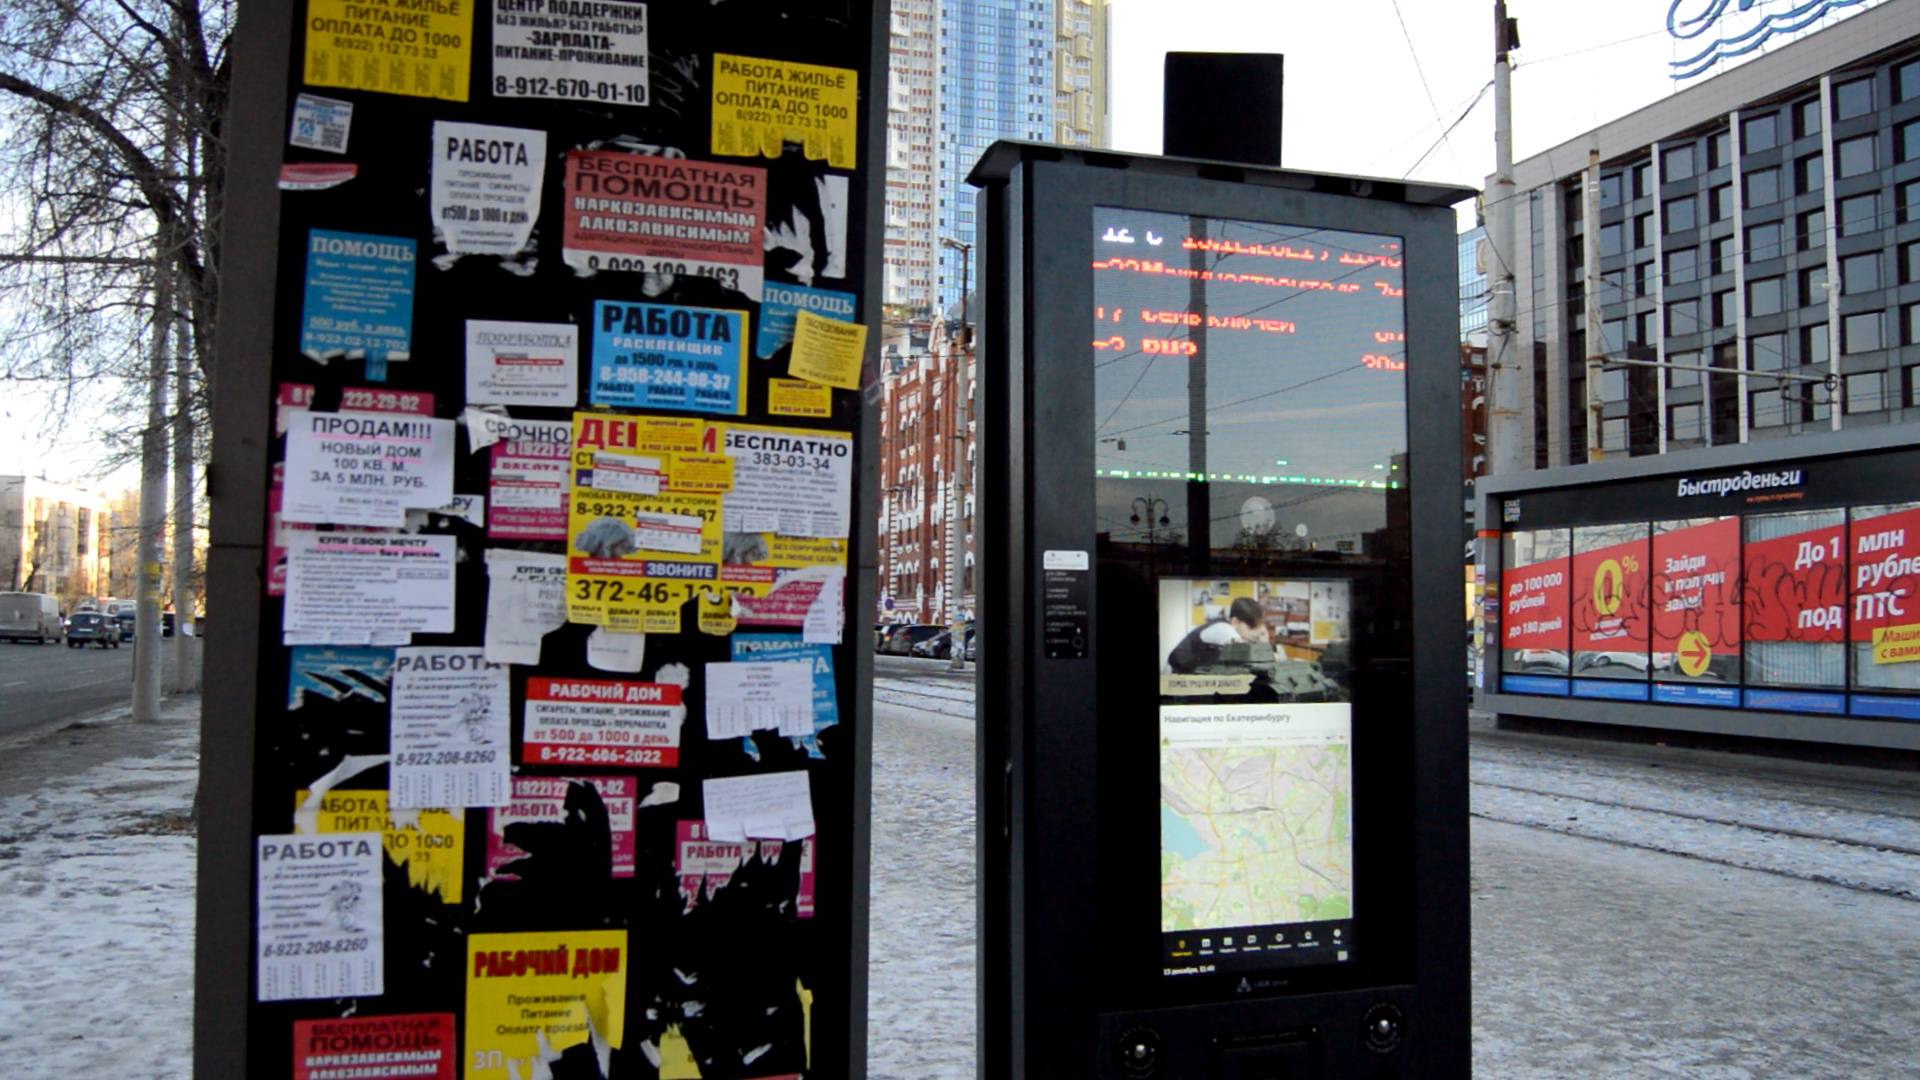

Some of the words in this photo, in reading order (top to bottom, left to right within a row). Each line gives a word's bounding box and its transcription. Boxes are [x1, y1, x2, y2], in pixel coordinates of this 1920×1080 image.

[346, 5, 430, 28] ПИТАНИЕ
[497, 0, 544, 13] ЦЕНТР
[549, 0, 642, 21] ПОДДЕРЖКИ
[311, 18, 385, 39] ОПЛАТА
[390, 27, 417, 44] ДО
[425, 32, 461, 48] 1000
[496, 15, 516, 26] БЕЗ
[569, 20, 589, 31] БЕЗ
[526, 30, 615, 50] -ЗАРПЛАТА-
[495, 45, 645, 68] ПИТАНИЕ-ПРОЖИВАНИЕ
[720, 60, 784, 81] РАБОТА
[496, 75, 645, 103] 8-912-670-01-10
[746, 80, 820, 101] ПИТАНИЕ
[716, 92, 781, 111] ОПЛАТА
[785, 100, 809, 115] ДО
[815, 104, 848, 120] 1000
[447, 136, 528, 167] РАБОТА
[578, 156, 756, 188] БЕСПЛАТНАЯ
[575, 172, 755, 210] ПОМОЩЬ
[574, 197, 757, 228] НАРКОЗАВИСИМЫМ
[579, 216, 750, 244] АЛКОЗАВИСИМЫМ
[311, 236, 415, 262] ПОМОЩЬ
[765, 287, 854, 314] ПОМОЩЬ
[602, 304, 732, 343] РАБОТА
[613, 336, 723, 356] РАСКЛЕЙЩИК
[632, 353, 665, 367] 1500
[312, 417, 432, 439] ПРОДАМ!!!
[320, 442, 381, 456] НОВЫЙ
[384, 444, 422, 459] ДОМ
[725, 434, 848, 457] БЕСПЛАТНО
[334, 458, 358, 470] 100
[363, 460, 386, 471] КВ.
[392, 461, 408, 473] М.
[752, 451, 831, 471] 383-03-34
[311, 470, 331, 483] ЗА
[337, 472, 344, 484] 5
[351, 474, 385, 486] МЛН.
[393, 475, 428, 489] РУБ.
[1678, 470, 1801, 497] Быстроденьги
[352, 537, 387, 546] СВОЮ
[1857, 528, 1905, 554] млн
[1664, 554, 1706, 574] Зайди
[1795, 541, 1824, 570] До
[1830, 537, 1840, 559] 1
[646, 563, 714, 578] ЗВОНИТЕ
[1509, 583, 1523, 597] до
[1509, 592, 1545, 614] рублей
[1855, 588, 1906, 621] ПТС
[1509, 626, 1521, 638] до
[1539, 616, 1562, 634] дней
[1798, 606, 1842, 630] под
[1881, 649, 1888, 659] с
[550, 683, 625, 699] РАБОЧИЙ
[626, 686, 662, 702] ДОМ
[1164, 714, 1211, 724] Навигация
[1226, 713, 1291, 724] Екатеринбургу
[550, 729, 576, 740] 500
[597, 731, 630, 743] 1000
[642, 735, 671, 745] день
[262, 840, 372, 861] РАБОТА
[687, 845, 742, 859] РАБОТА
[474, 944, 568, 978] РАБОЧИЙ
[572, 947, 620, 979] ДОМ
[507, 994, 586, 1006] Проживание
[521, 1009, 572, 1020] Питание
[312, 1019, 440, 1036] БЕСПЛАТНАЯ
[309, 1032, 440, 1052] ПОМОЩЬ
[305, 1050, 441, 1067] НАРКОЗАВИСИМЫМ
[474, 1050, 502, 1070] ЗП
[309, 1064, 437, 1080] АЛКОЗАВИСИМЫМ
